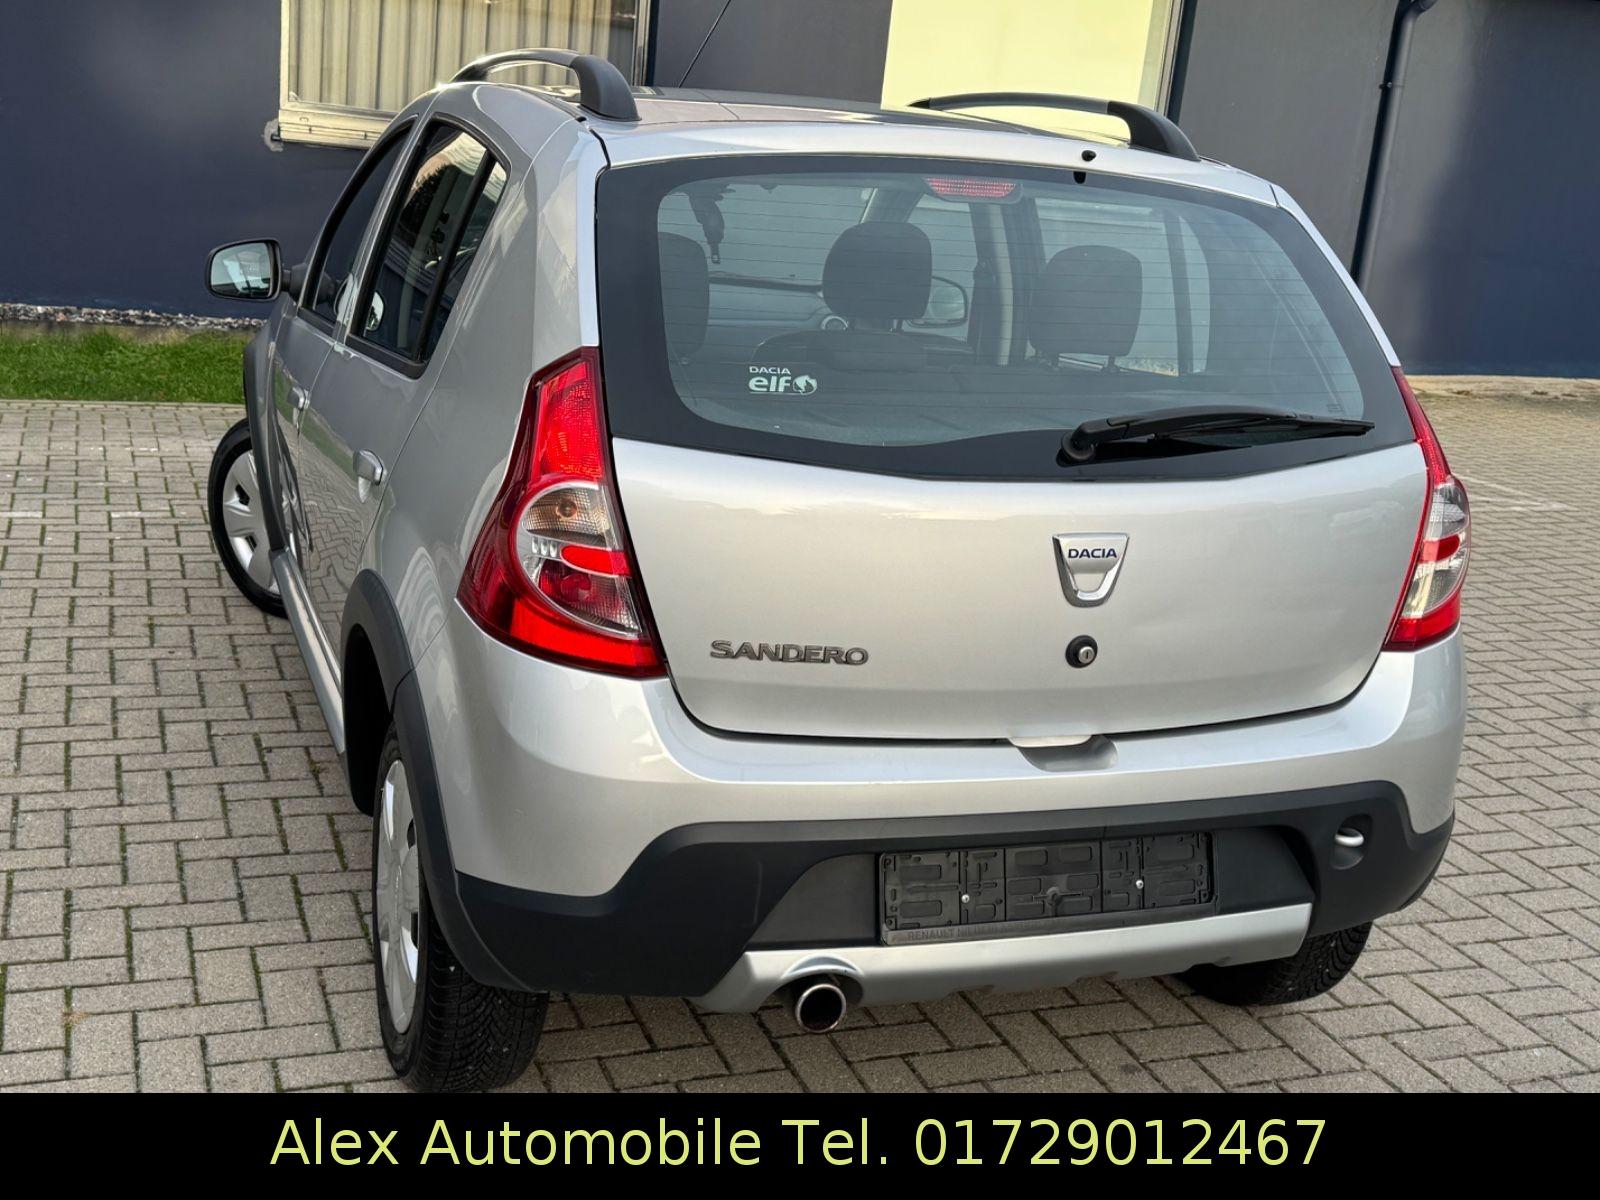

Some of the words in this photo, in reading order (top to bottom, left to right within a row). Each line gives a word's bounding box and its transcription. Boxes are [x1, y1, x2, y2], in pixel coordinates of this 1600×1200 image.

[749, 365, 792, 375] DACIA
[748, 375, 792, 392] elf
[1067, 548, 1117, 559] DACIA
[710, 639, 869, 666] SANDERO
